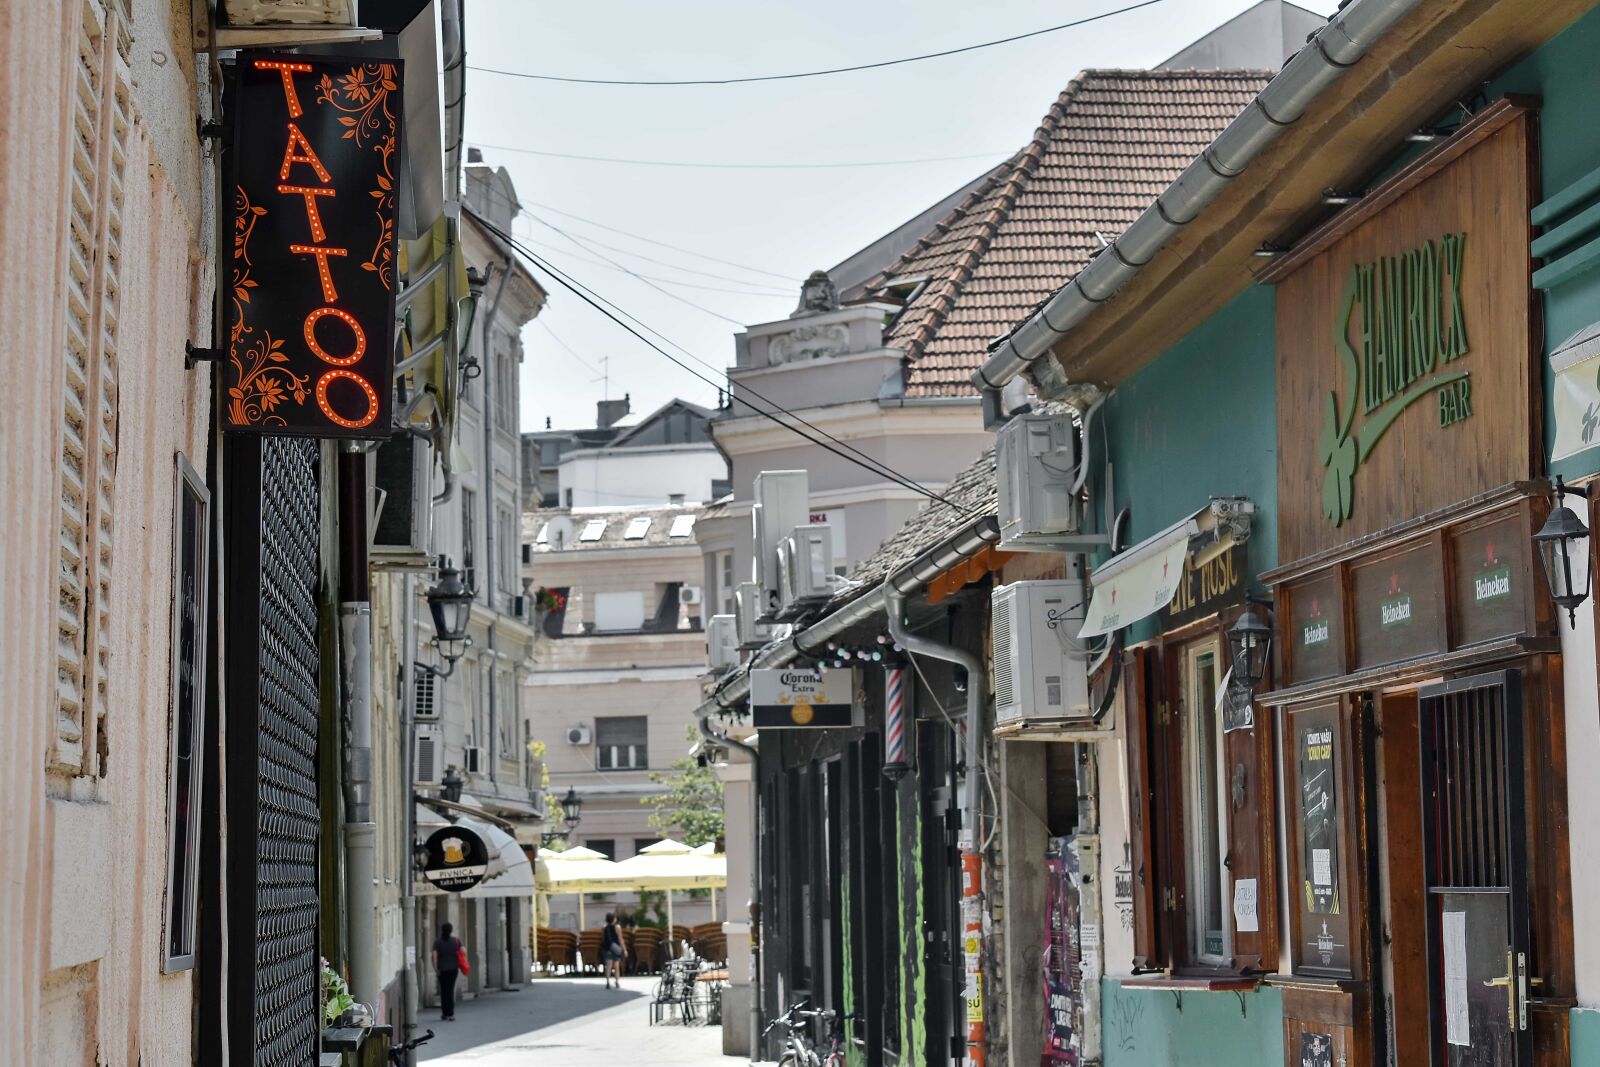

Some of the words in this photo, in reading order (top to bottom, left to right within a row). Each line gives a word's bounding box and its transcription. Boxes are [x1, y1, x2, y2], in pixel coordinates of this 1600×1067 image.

[253, 60, 379, 429] TATTOO
[1336, 231, 1470, 443] SHAMROCK
[1439, 377, 1473, 429] BAR
[1475, 574, 1510, 600] Heineken
[1381, 601, 1411, 625] Heineken
[1304, 623, 1329, 645] Heineken
[780, 672, 823, 686] Corona
[791, 683, 815, 693] Extra
[440, 869, 473, 878] PIVNICA
